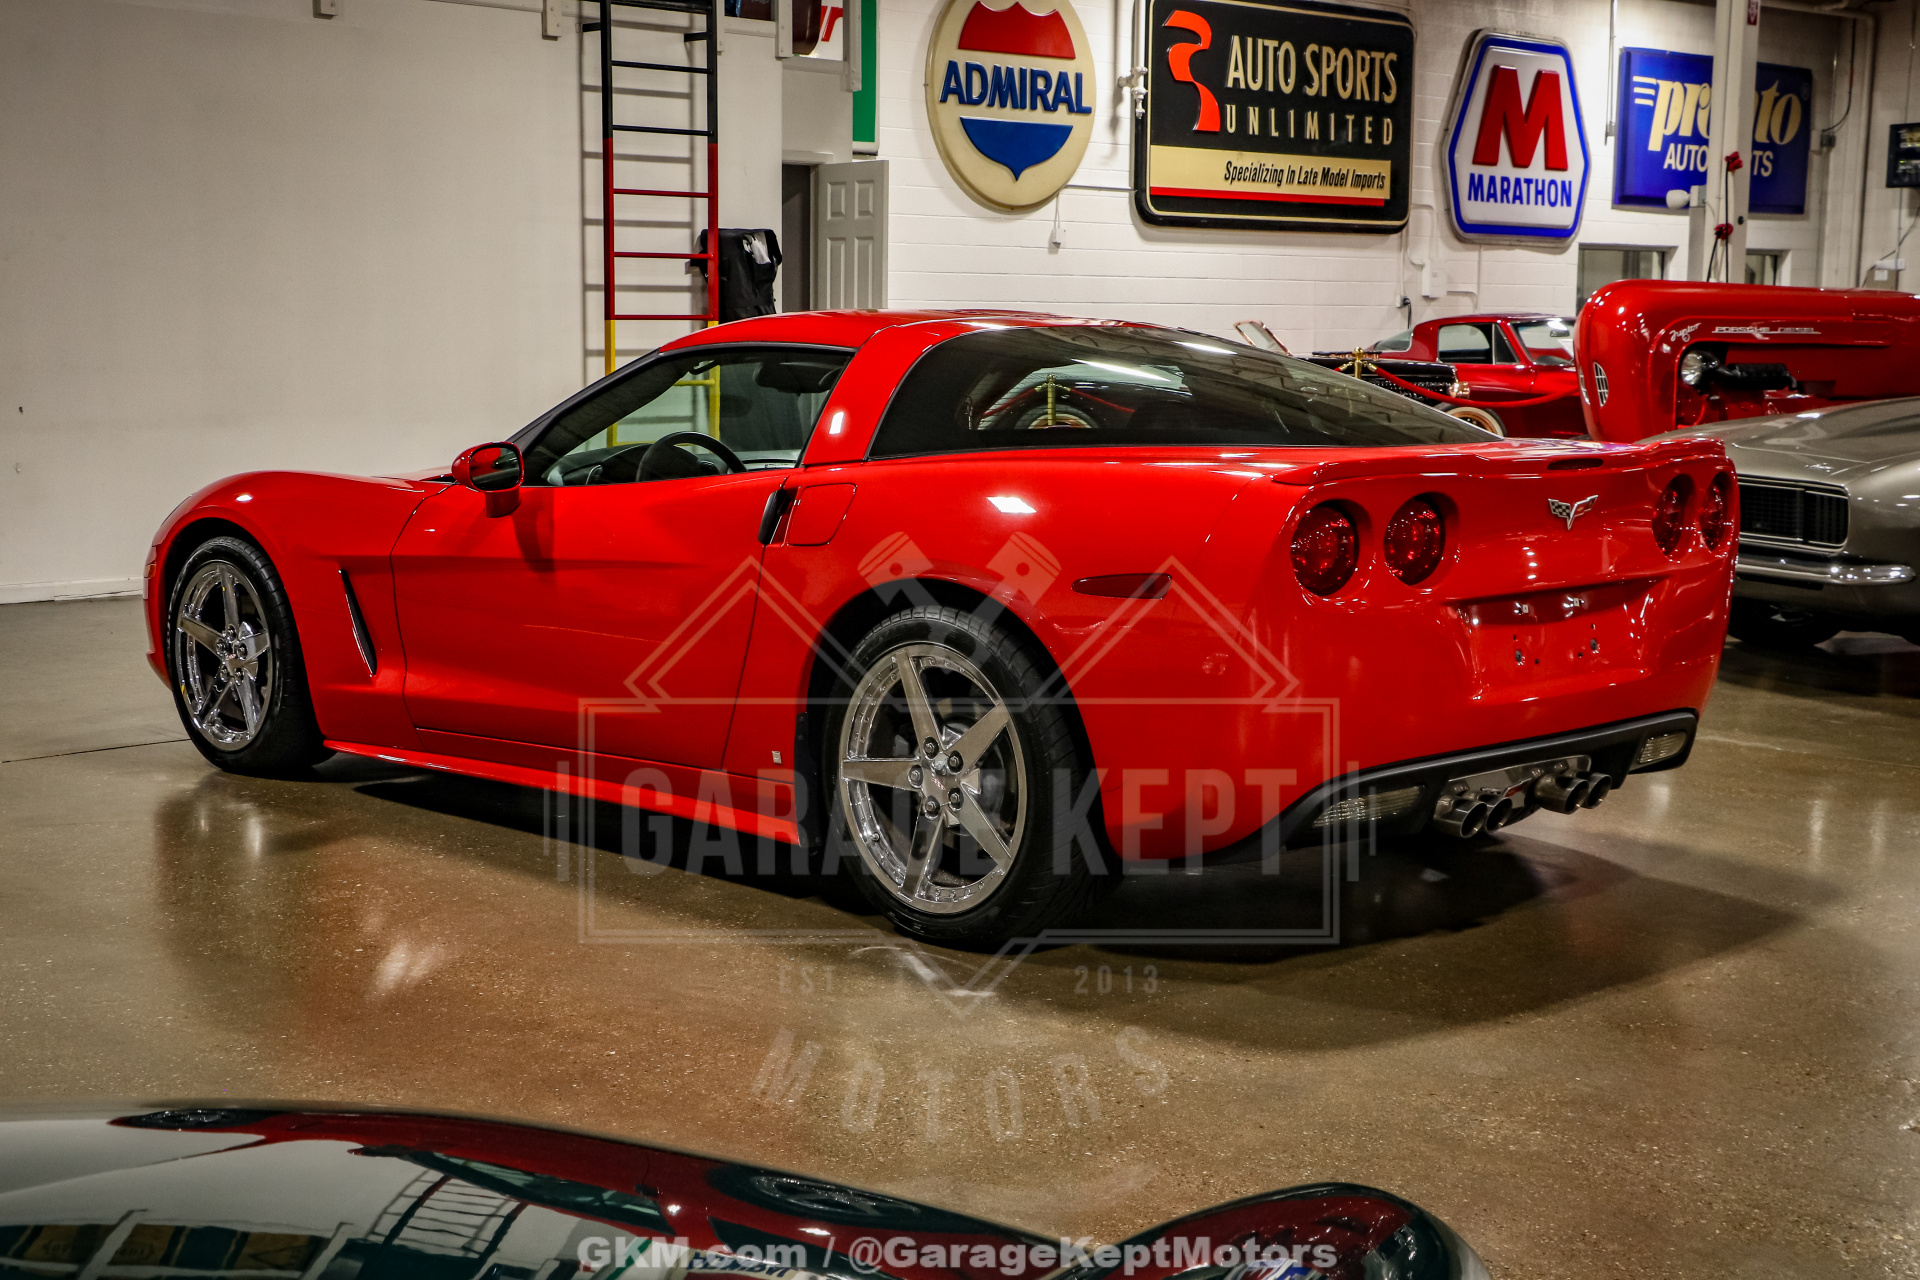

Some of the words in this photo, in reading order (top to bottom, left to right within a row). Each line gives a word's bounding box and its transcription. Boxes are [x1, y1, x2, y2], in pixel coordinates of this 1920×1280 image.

[939, 59, 1092, 114] ADMIRAL
[1225, 35, 1296, 94] AUTO
[1303, 43, 1398, 104] SPORTS
[1225, 104, 1393, 146] UNLIMITED
[1472, 64, 1568, 171] M
[1648, 79, 1802, 151] prto
[1224, 160, 1284, 188] Specializing
[1285, 164, 1296, 184] In
[1297, 165, 1318, 186] Late
[1320, 166, 1349, 187] Model
[1350, 169, 1386, 191] Imports
[1663, 142, 1709, 172] AUTO
[1468, 172, 1572, 207] MARATHON
